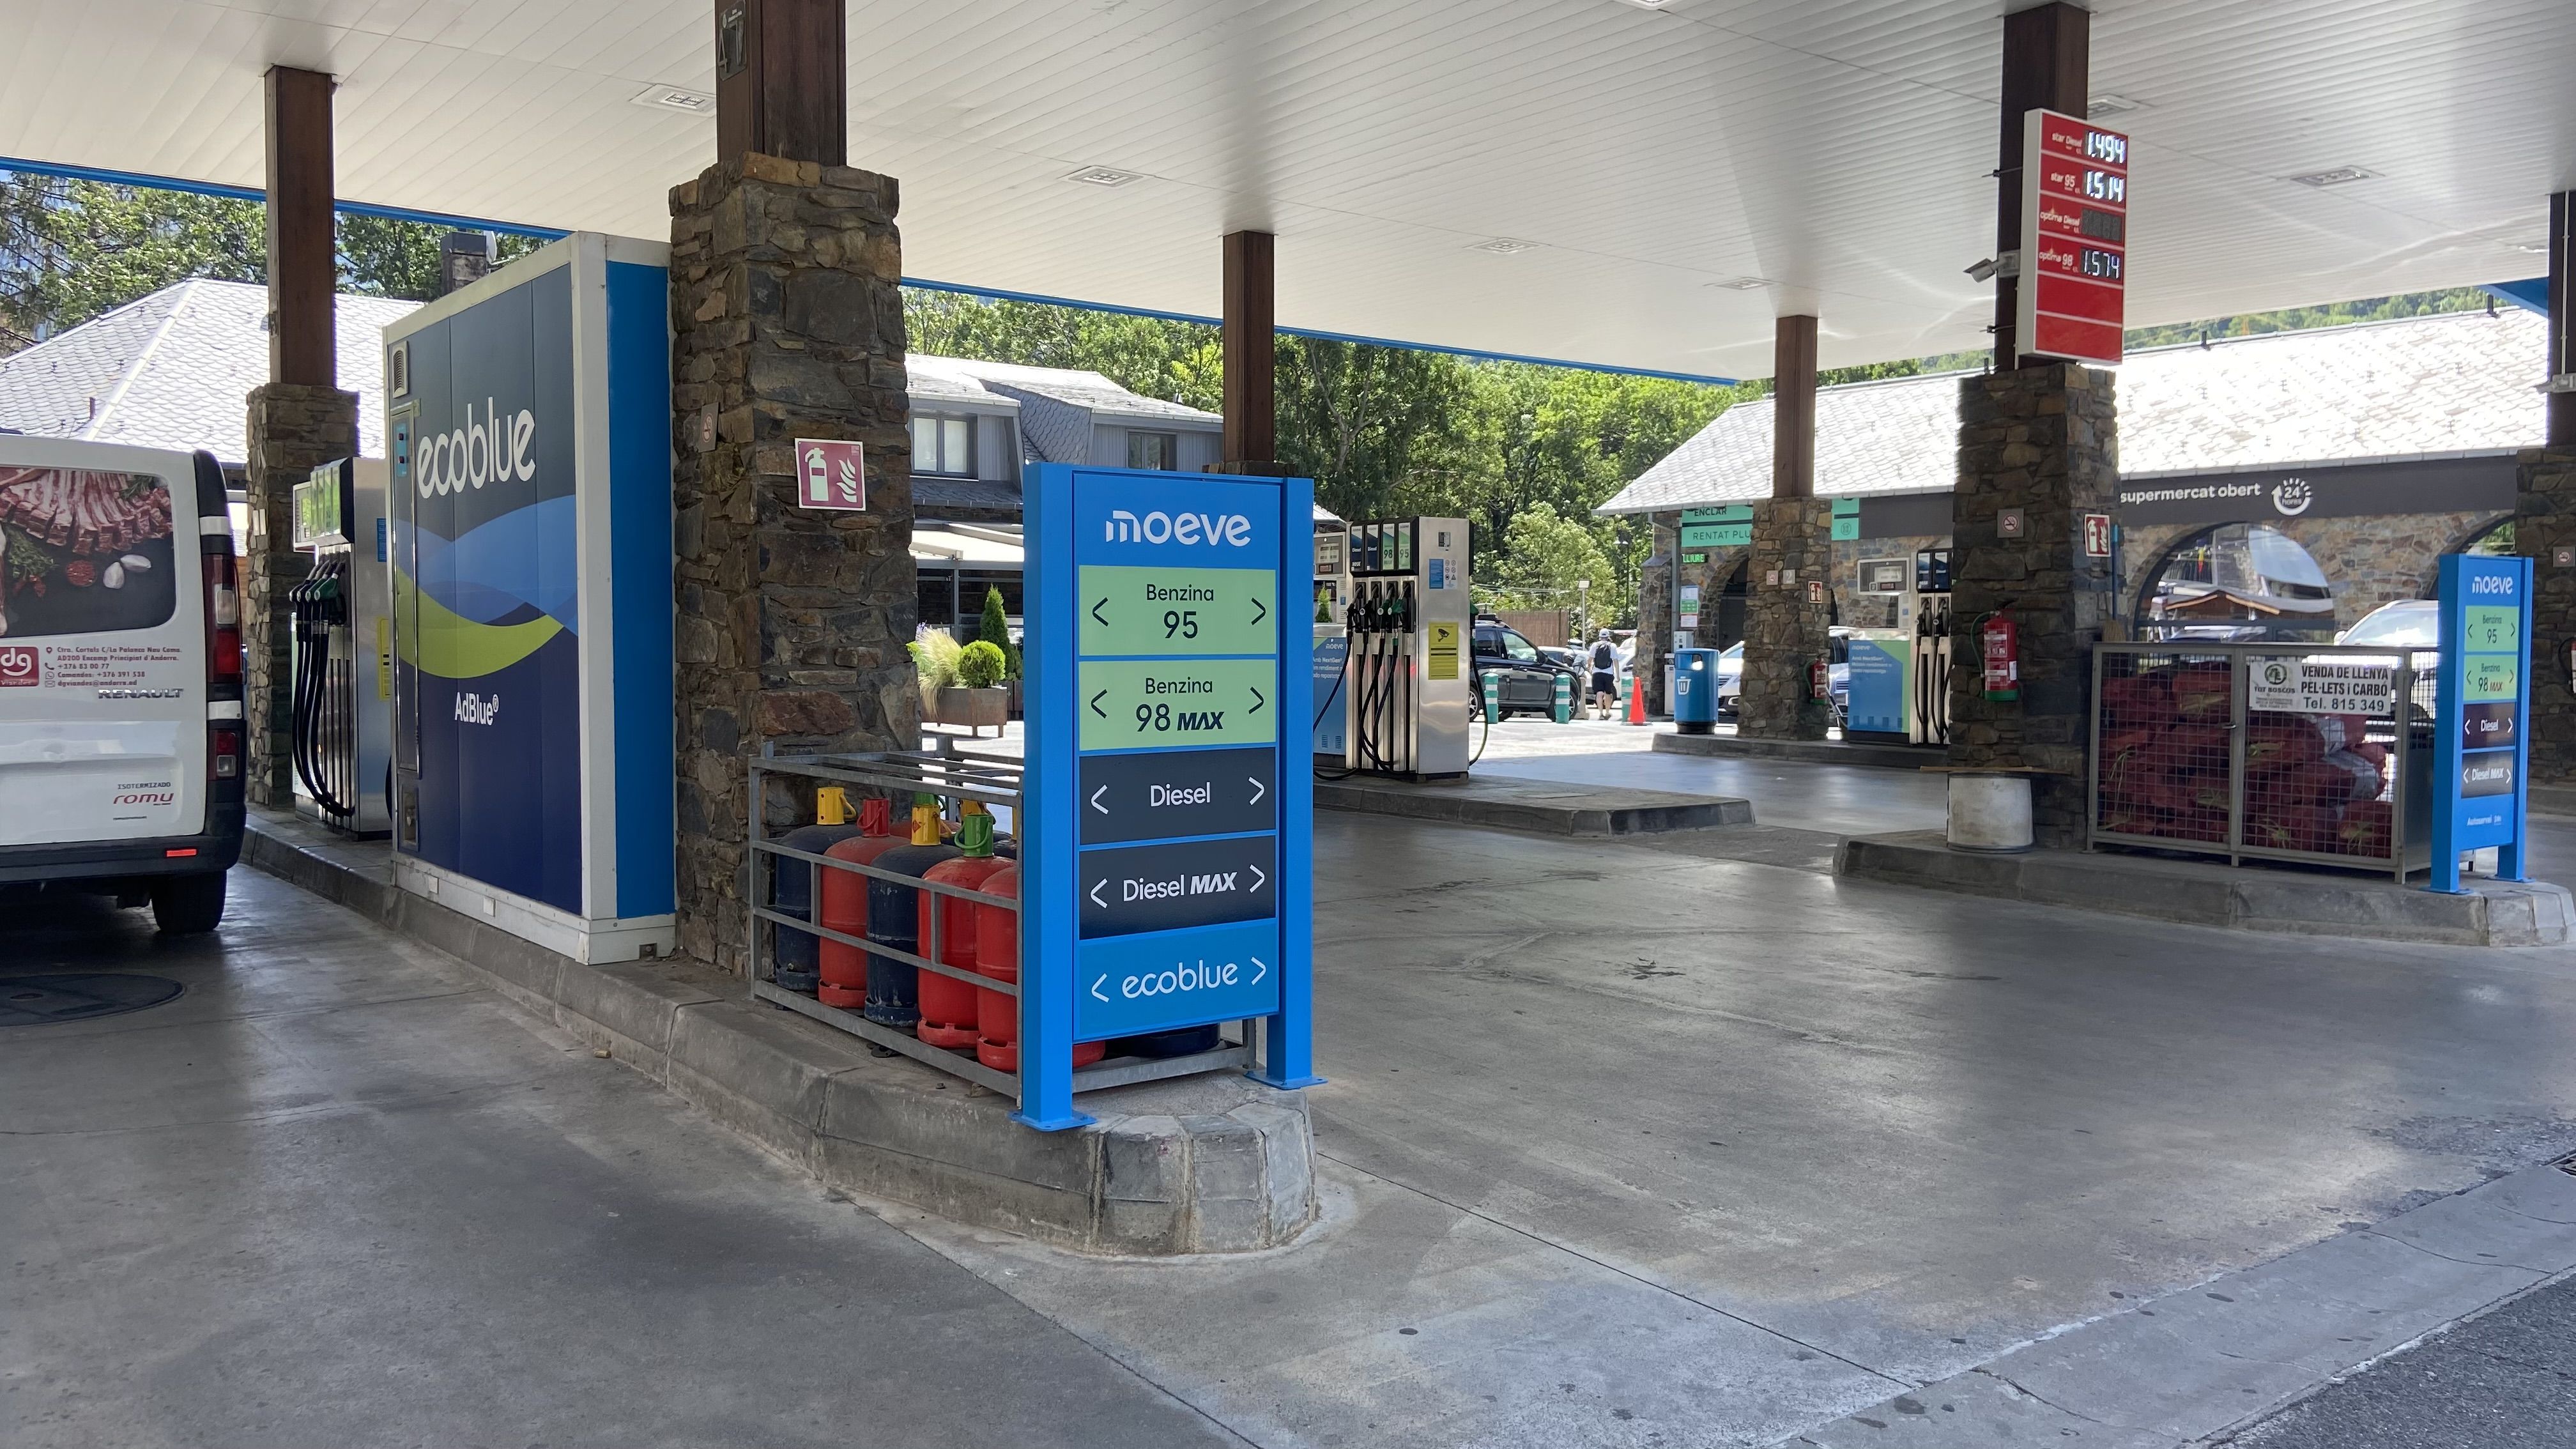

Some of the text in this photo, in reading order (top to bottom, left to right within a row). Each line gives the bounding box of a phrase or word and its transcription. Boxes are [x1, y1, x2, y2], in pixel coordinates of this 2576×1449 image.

[2087, 131, 2127, 164] 1.494
[2064, 174, 2075, 188] 95
[2086, 171, 2125, 203] 1.514
[2062, 253, 2073, 267] 98
[2084, 250, 2120, 279] 1.574
[417, 396, 536, 499] ecoblue
[2120, 483, 2262, 505] supermercat obert
[2284, 486, 2300, 499] 24
[1694, 507, 1727, 517] ENCLAR
[1106, 510, 1251, 547] moeve
[1693, 530, 1729, 540] RENTAT
[1384, 549, 1393, 559] 98
[1399, 549, 1409, 558] 95
[1146, 583, 1214, 602] Benzina
[2472, 576, 2513, 595] moeve
[1163, 610, 1199, 640] 95
[2483, 614, 2502, 624] Benzina
[2487, 628, 2497, 644] 95
[2301, 664, 2389, 680] VENDA DE LLENYA
[2481, 663, 2501, 673] Benzina
[1146, 676, 1213, 695] Benzina
[2352, 680, 2388, 697] CARBÓ
[2478, 677, 2503, 693] 98 MAX
[98, 688, 184, 699] RENAULT
[2303, 696, 2327, 710] Tel.
[2331, 698, 2355, 710] 815
[2360, 698, 2384, 712] 349
[1136, 703, 1225, 733] 98 MAX
[2480, 718, 2499, 732] Diesel
[2472, 767, 2504, 781] Diesel MAX
[118, 781, 171, 790] ISOTERMIZADO
[1150, 781, 1211, 807] Diesel
[1123, 871, 1238, 901] Diesel MAX
[1122, 960, 1239, 999] ecoblue
